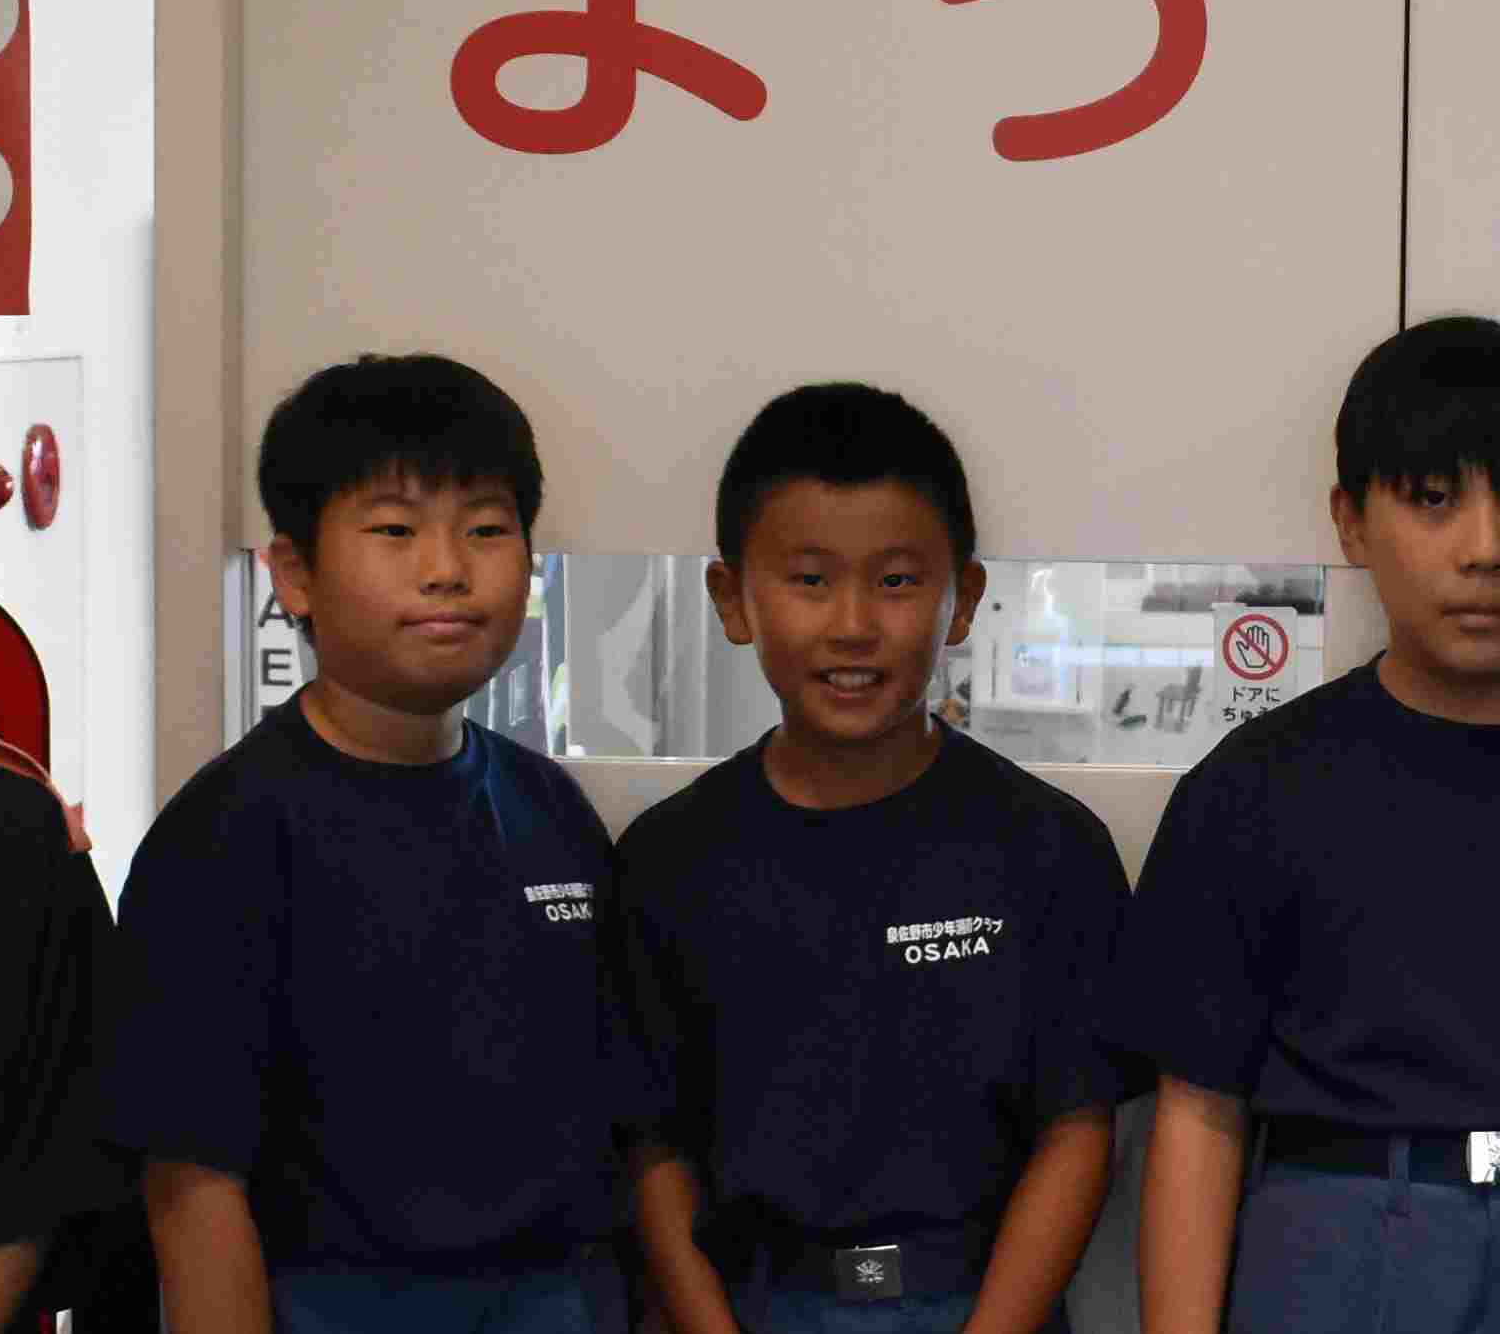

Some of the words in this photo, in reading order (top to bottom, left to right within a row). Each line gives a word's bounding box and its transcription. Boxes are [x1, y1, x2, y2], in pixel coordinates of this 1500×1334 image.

[1232, 687, 1280, 703] ドアに
[904, 936, 990, 964] OSAKA
